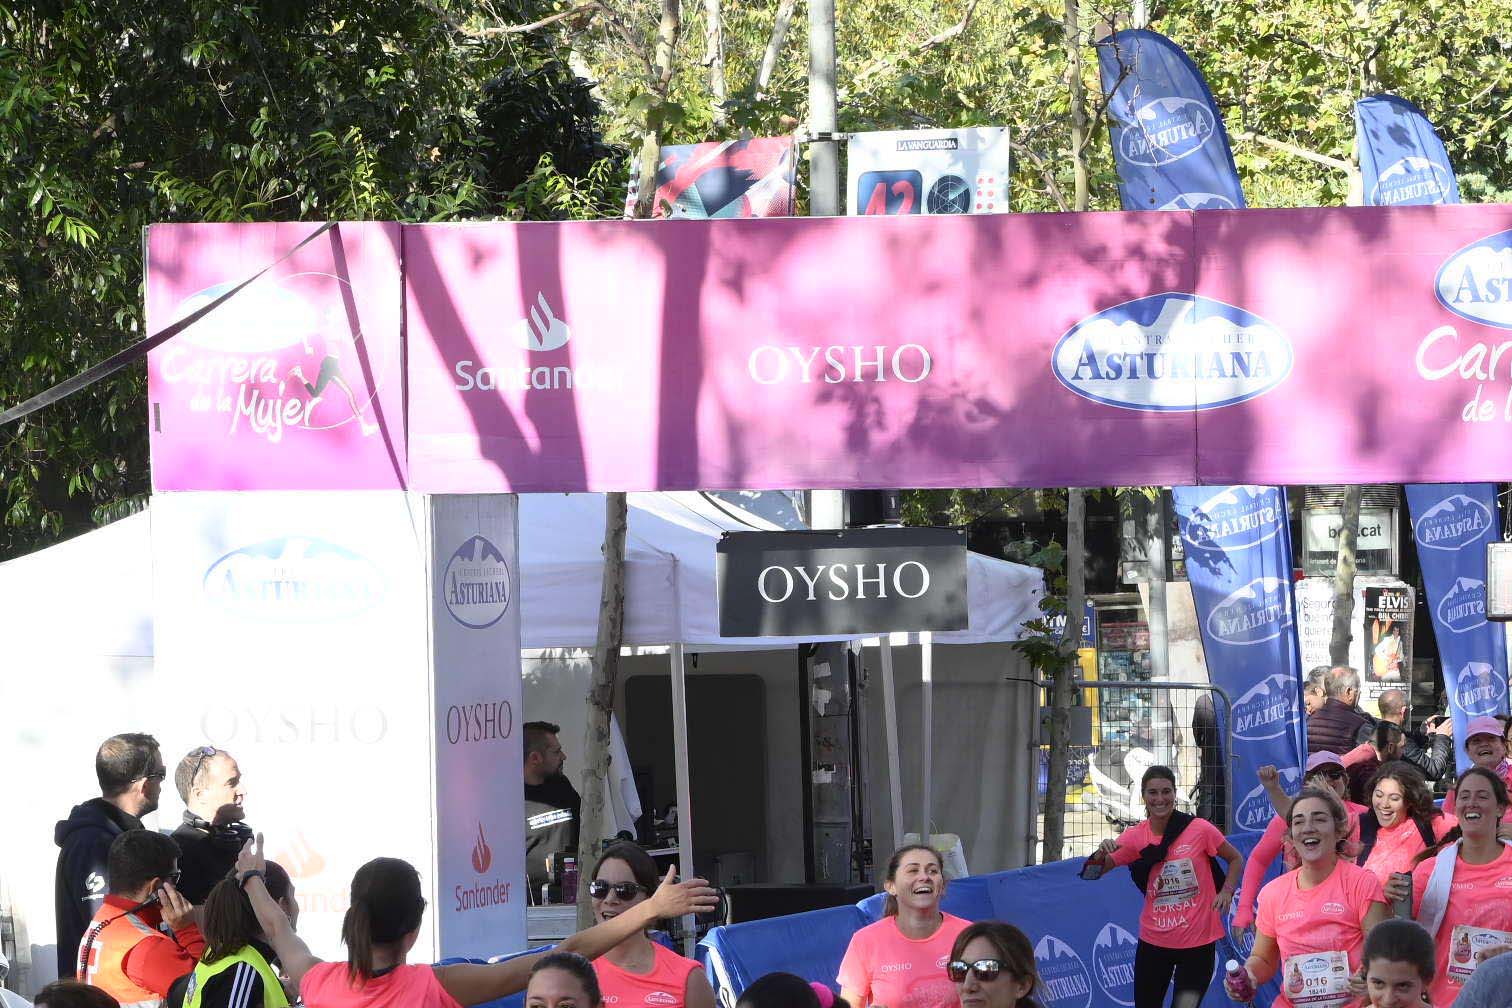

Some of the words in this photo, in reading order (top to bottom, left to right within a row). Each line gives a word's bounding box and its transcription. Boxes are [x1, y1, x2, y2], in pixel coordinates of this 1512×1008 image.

[909, 139, 957, 150] VANGUARDIA
[748, 343, 932, 385] OYSHO
[1071, 339, 1273, 381] ASTURIANA
[229, 380, 323, 442] Mujer
[1461, 384, 1495, 423] de
[450, 573, 507, 606] ASTURIANA
[758, 560, 931, 603] OYSHO
[1379, 596, 1409, 609] ELVIS
[447, 701, 513, 745] OYSHO
[455, 879, 511, 912] Santander
[1305, 976, 1328, 987] 016
